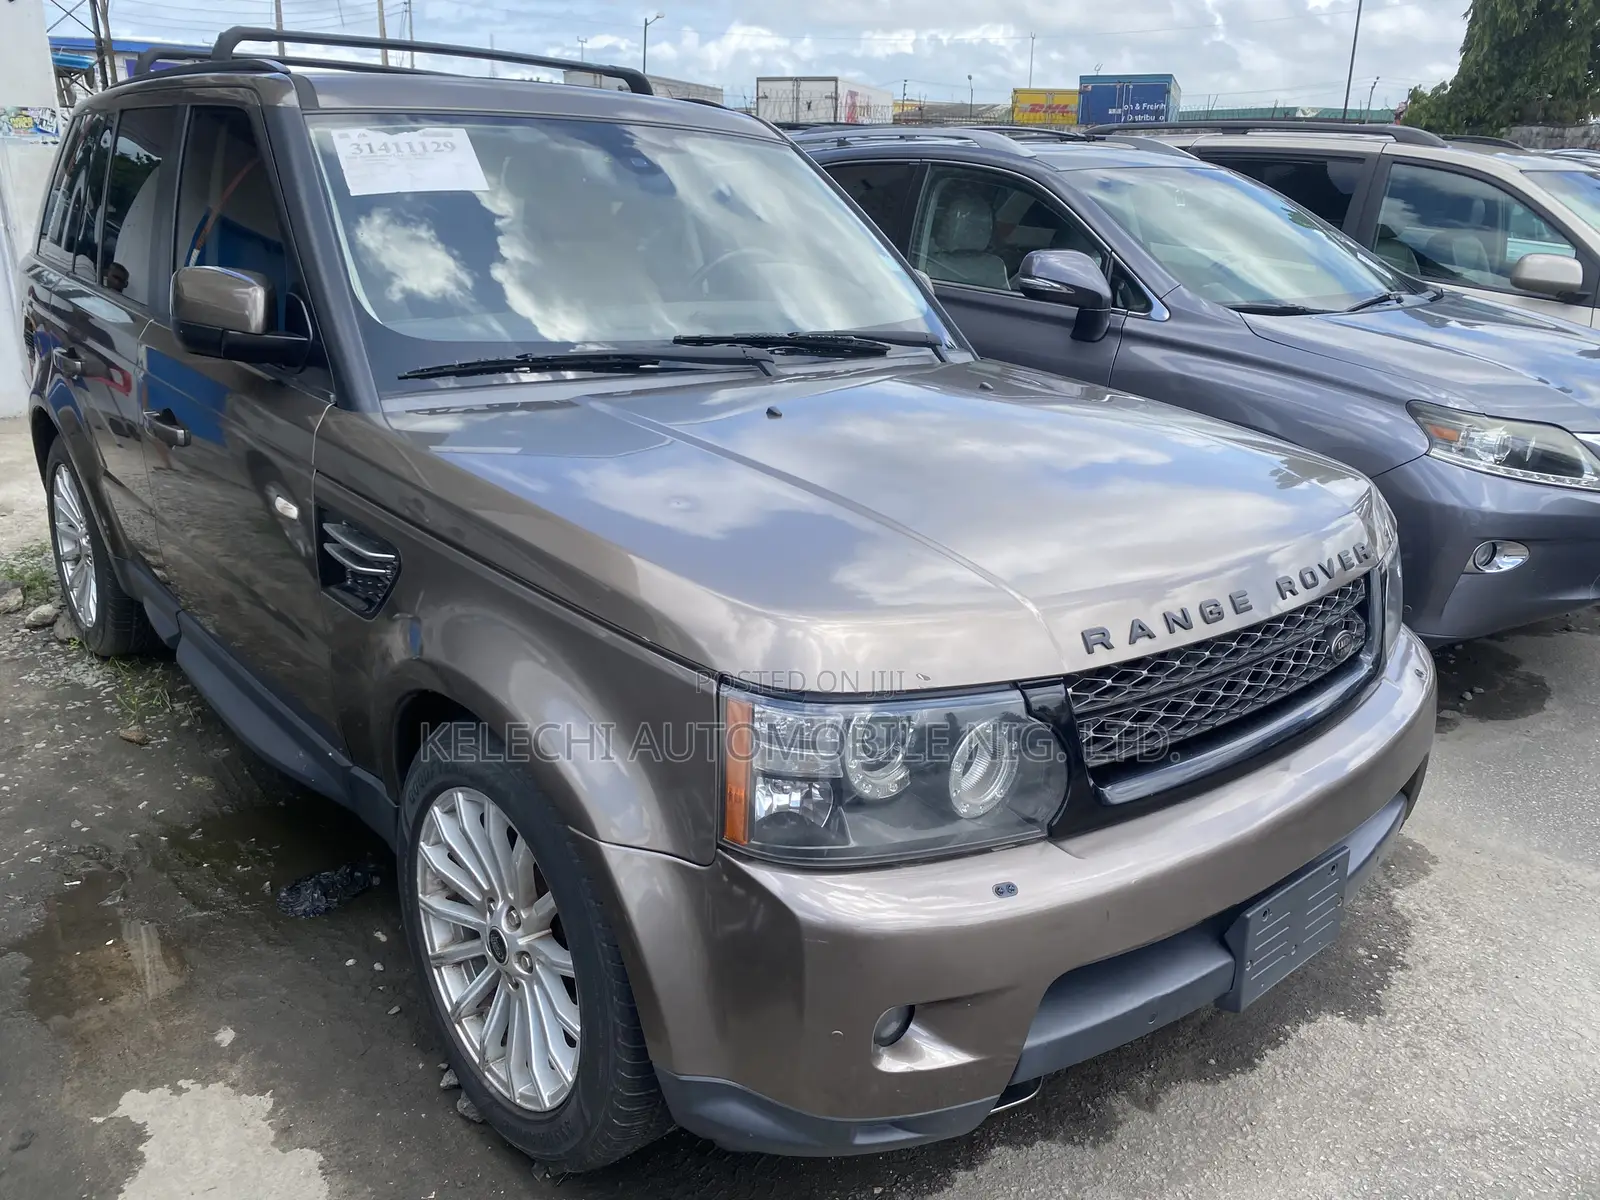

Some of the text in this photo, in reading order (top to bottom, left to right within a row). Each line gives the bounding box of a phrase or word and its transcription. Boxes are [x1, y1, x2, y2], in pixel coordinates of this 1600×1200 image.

[351, 141, 456, 155] 31411129
[1080, 541, 1374, 655] RANGE ROVER
